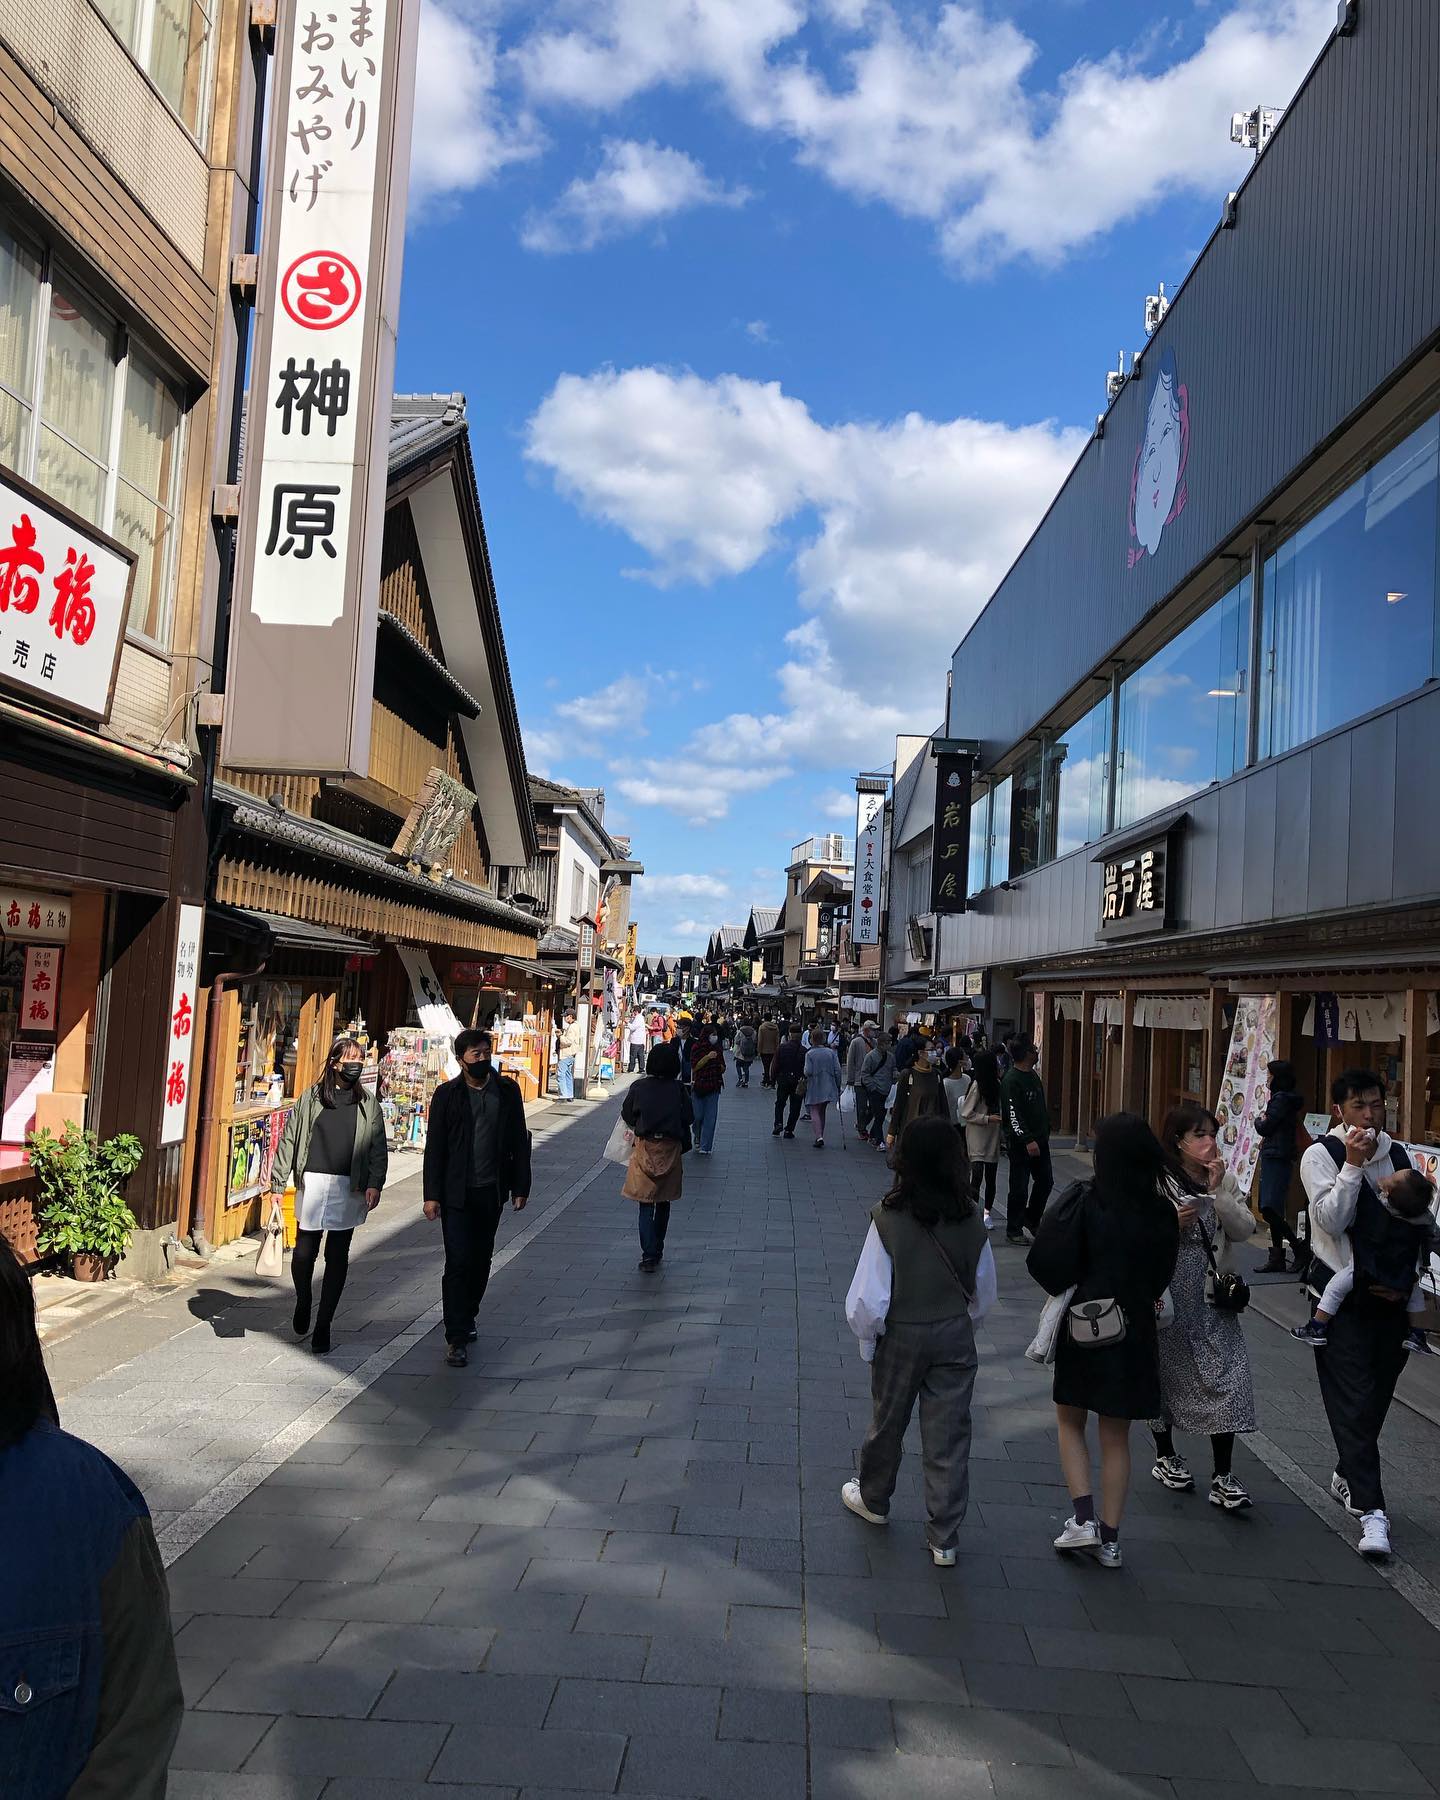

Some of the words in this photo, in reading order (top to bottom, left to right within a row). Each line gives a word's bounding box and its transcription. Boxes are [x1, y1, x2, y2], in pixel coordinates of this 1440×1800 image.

[341, 0, 376, 151] まいり
[290, 11, 338, 212] おみやげ
[265, 357, 351, 559] 榊原
[0, 513, 96, 646] 赤福
[0, 630, 57, 681] 売店
[863, 858, 874, 895] 大食堂
[938, 801, 961, 898] 岩戸屋
[1102, 850, 1154, 919] 岩戸屋
[6, 900, 41, 930] 赤福
[46, 909, 67, 929] 名物
[860, 916, 872, 940] 商店
[177, 941, 187, 978] 名物
[186, 940, 196, 979] 伊勢
[28, 970, 51, 1020] 赤福
[167, 992, 192, 1107] 赤福
